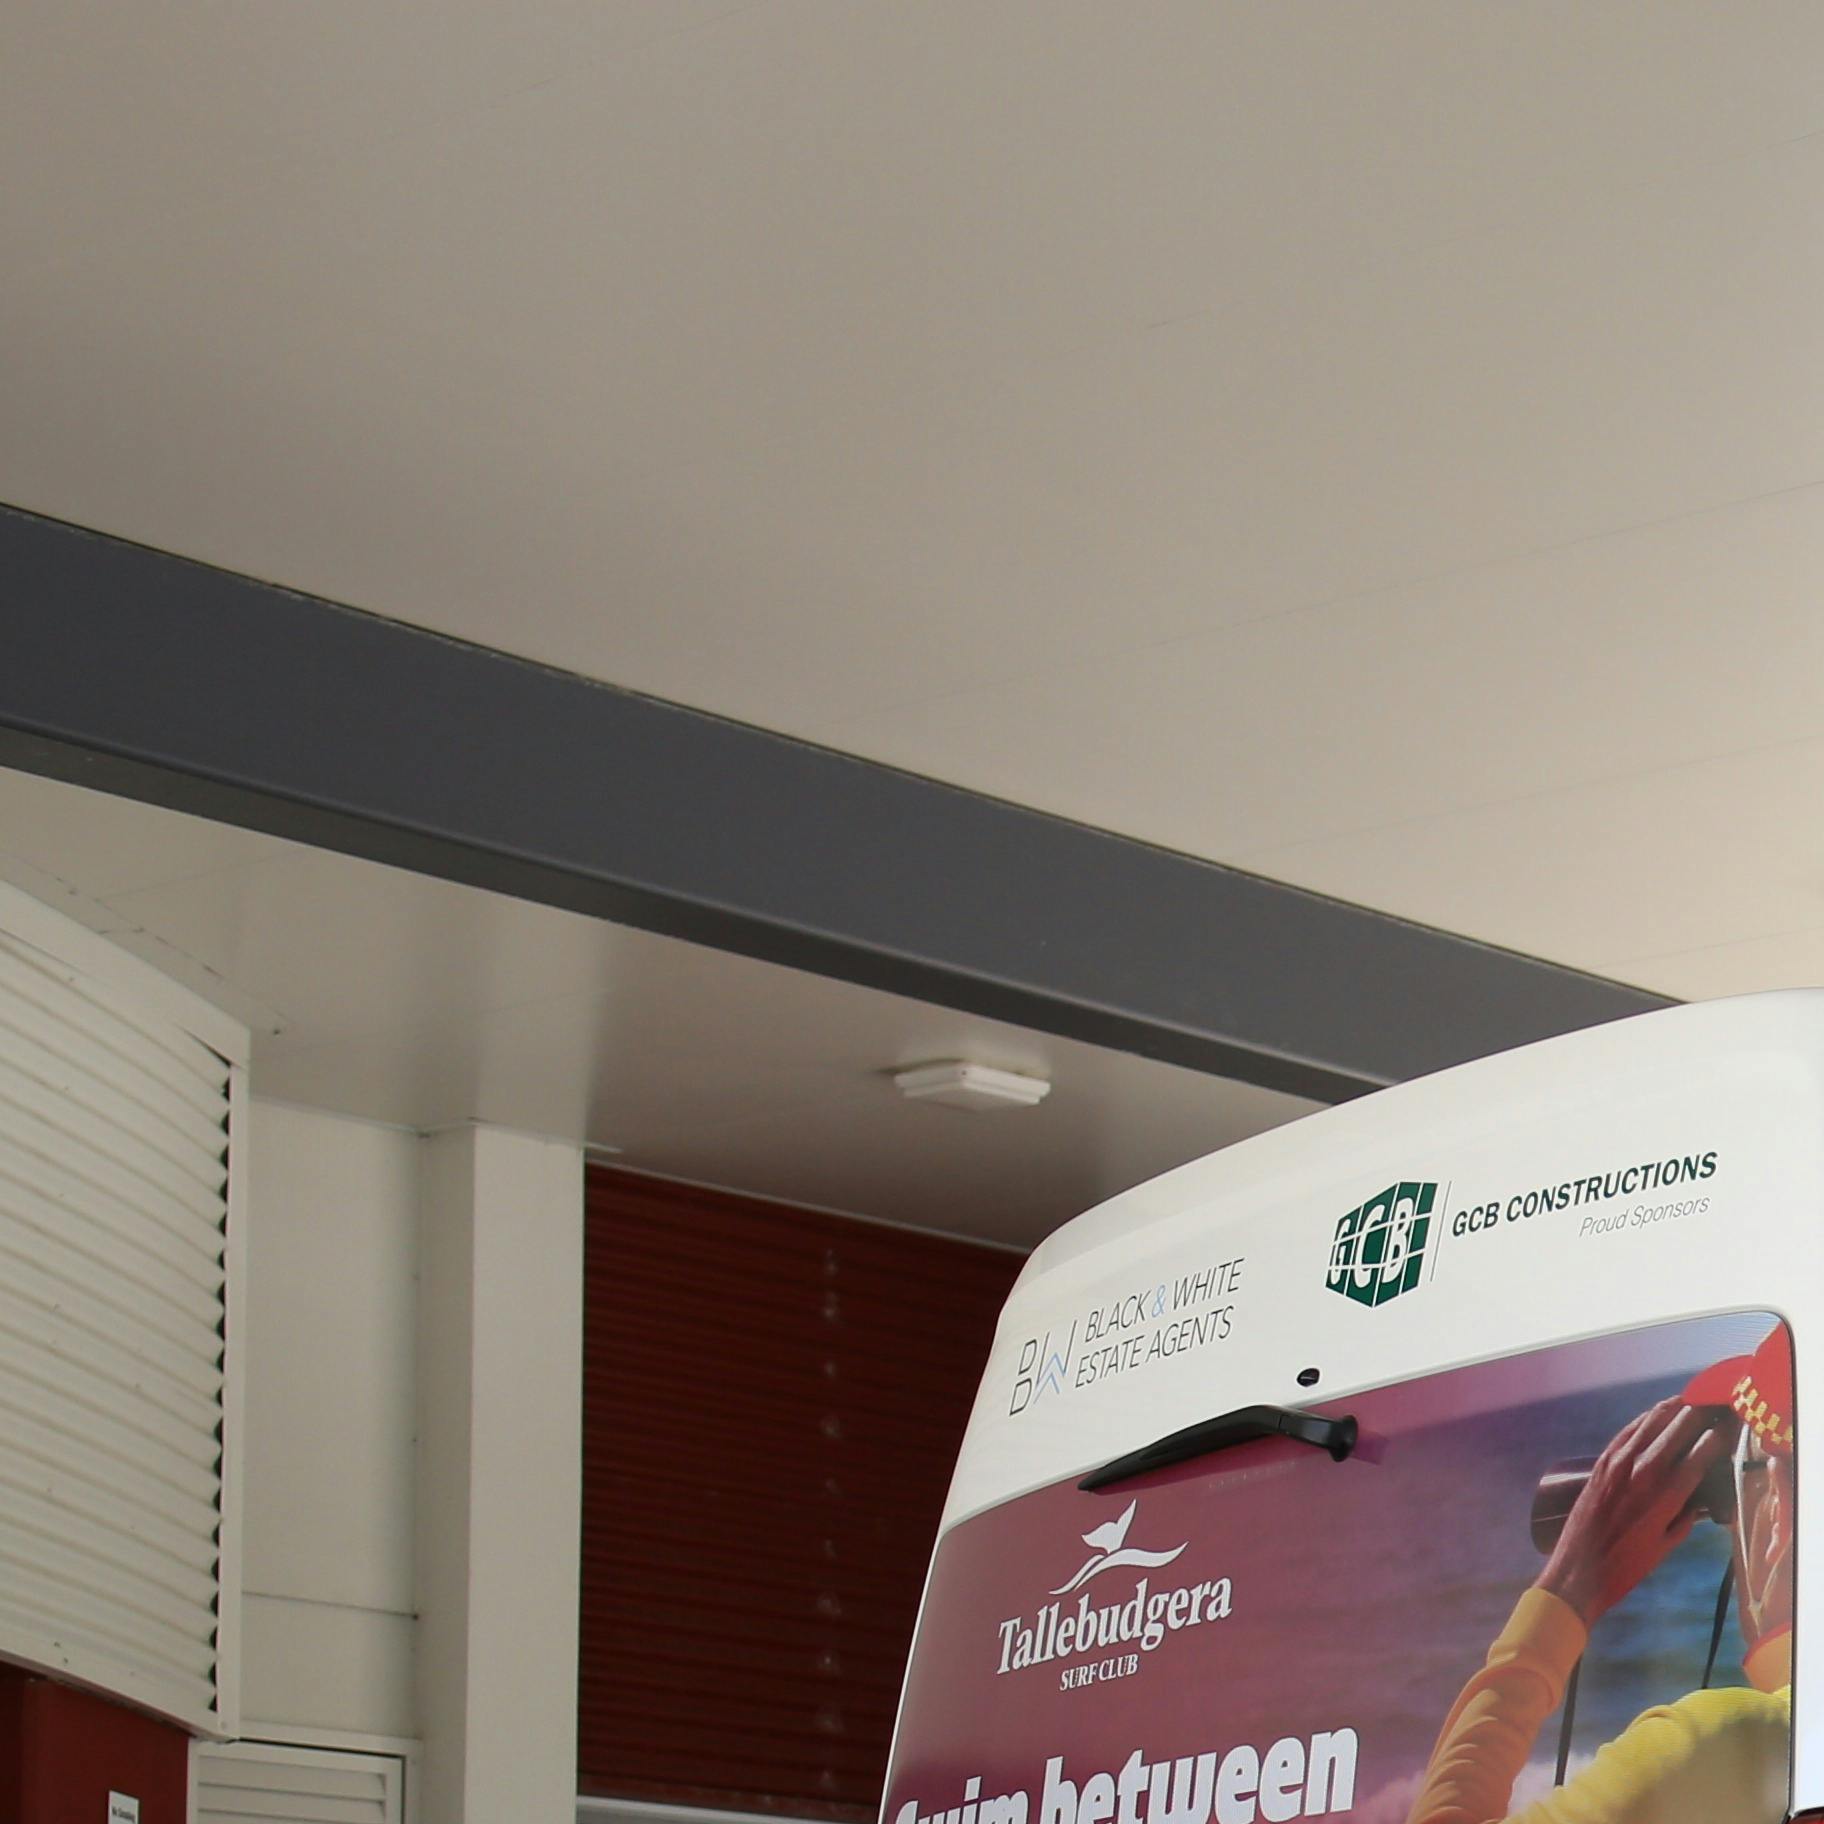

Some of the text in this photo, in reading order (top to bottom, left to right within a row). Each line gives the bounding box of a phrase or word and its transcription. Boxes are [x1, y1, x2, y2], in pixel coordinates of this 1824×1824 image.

[1453, 1151, 1719, 1238] GCB CONSTRUCTIONS
[1579, 1196, 1711, 1238] Proud Sponsors
[1085, 1257, 1246, 1344] BLACK & WHITE
[1074, 1304, 1235, 1388] ESTATE AGENTS
[996, 1576, 1233, 1676] Tallebudgera
[1059, 1653, 1139, 1691] SURF CLUB
